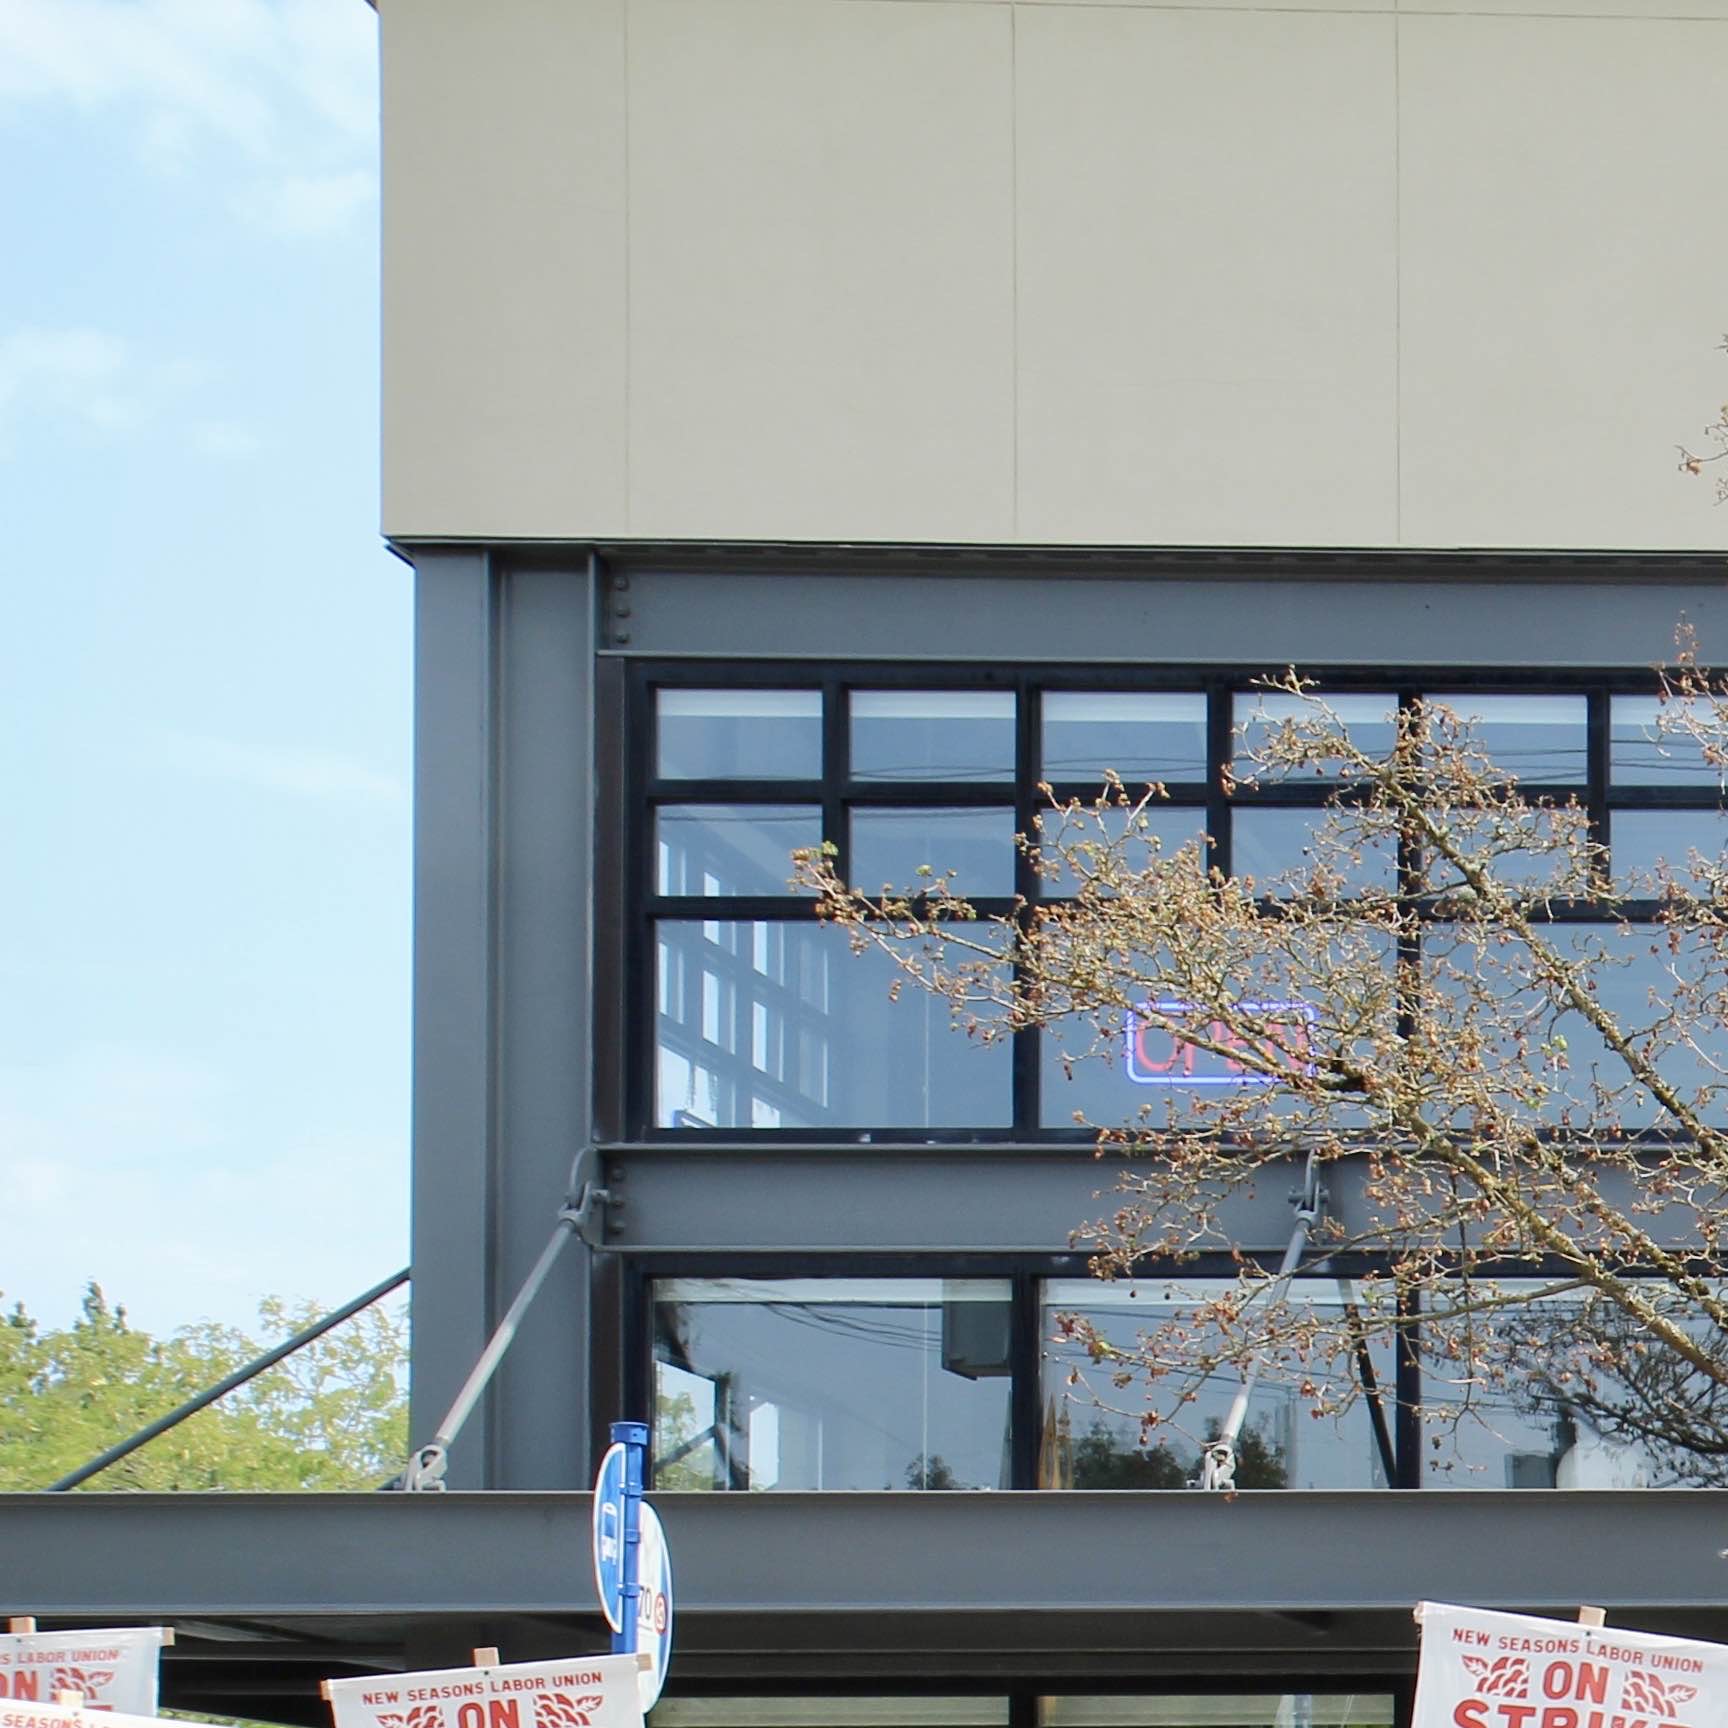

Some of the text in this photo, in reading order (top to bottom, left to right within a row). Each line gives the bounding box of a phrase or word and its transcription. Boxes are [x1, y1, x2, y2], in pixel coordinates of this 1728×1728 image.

[18, 1651, 65, 1664] LABOR
[71, 1650, 119, 1663] UNION
[1453, 1630, 1703, 1673] NEW SEASONS LABOR UNION
[0, 1671, 38, 1702] N
[362, 1673, 603, 1704] NEW SEASONS LABOR UNION
[1544, 1661, 1608, 1704] ON
